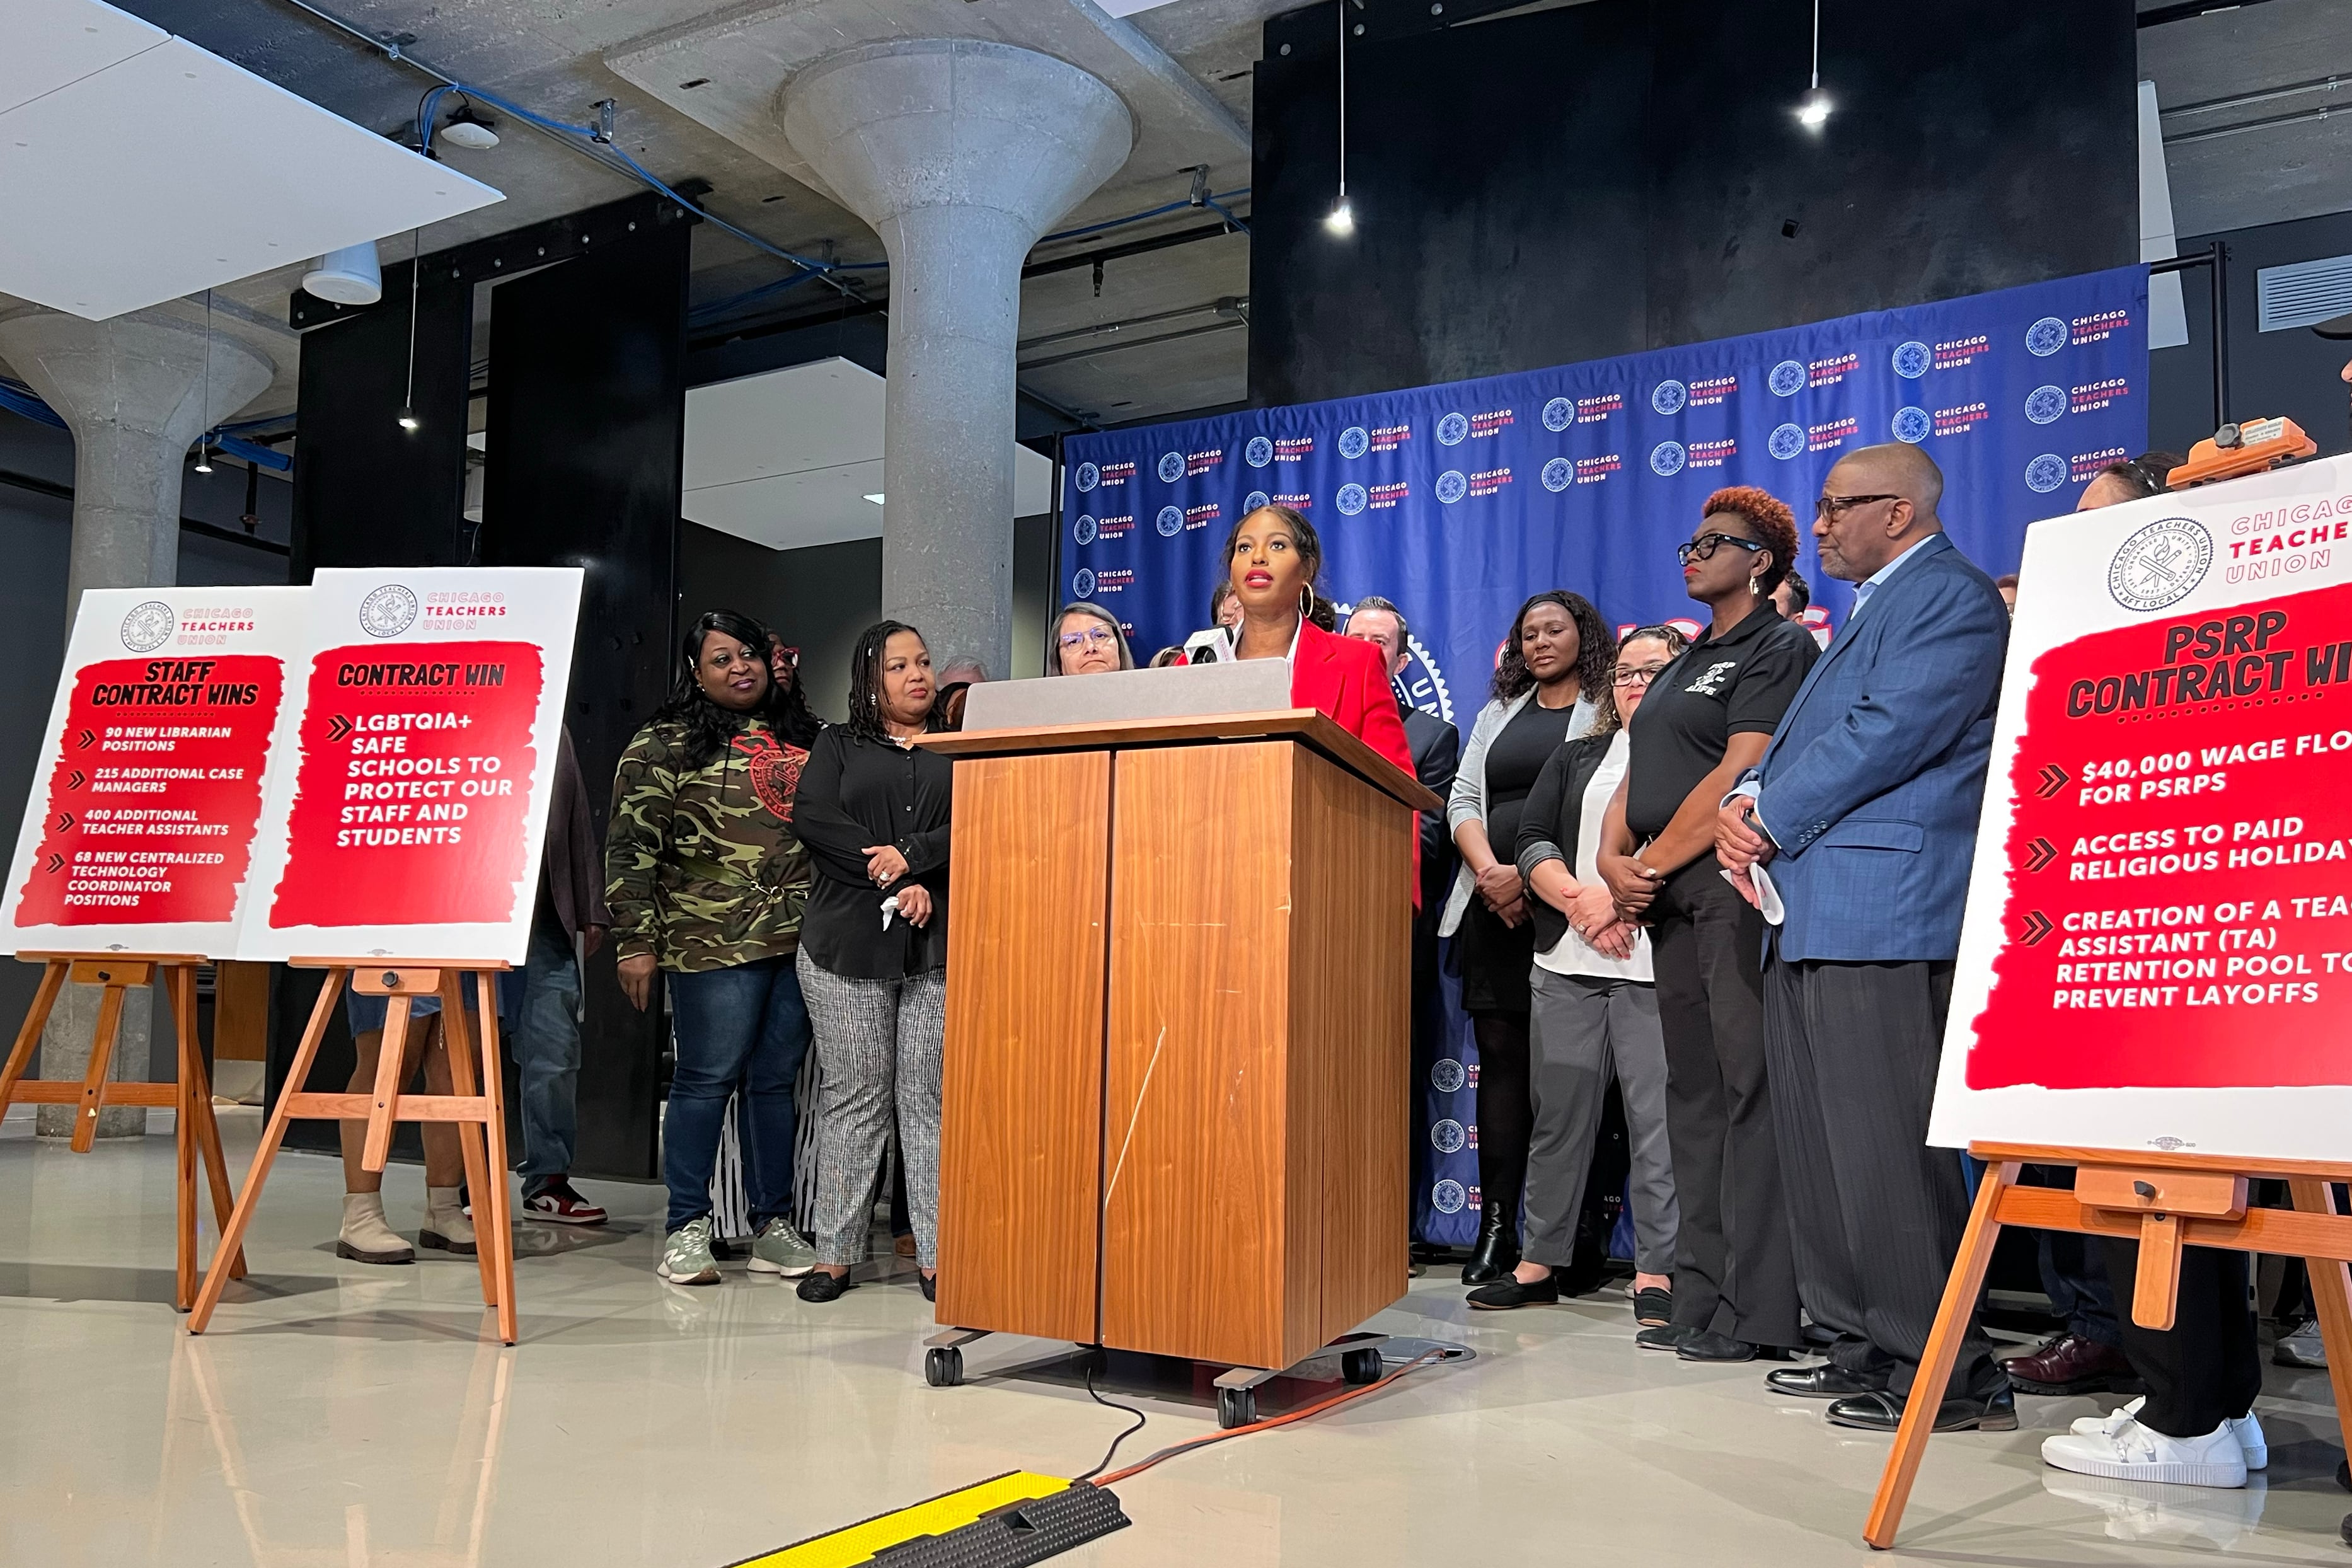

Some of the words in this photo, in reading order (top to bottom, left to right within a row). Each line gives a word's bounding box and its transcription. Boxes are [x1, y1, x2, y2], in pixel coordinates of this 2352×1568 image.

[2072, 309, 2126, 326] CHICAGO
[2073, 318, 2130, 335] TEACHERS
[1935, 335, 1986, 351] CHICAGO
[2072, 331, 2109, 345] UNION
[1935, 343, 1990, 360] TEACHERS
[1809, 353, 1857, 370] CHICAGO
[1935, 357, 1971, 370] UNION
[1809, 360, 1860, 378] TEACHERS
[1690, 376, 1736, 389] CHICAGO
[1809, 374, 1842, 388] UNION
[2071, 378, 2125, 395] CHICAGO
[1690, 384, 1738, 398] TEACHERS
[2072, 386, 2129, 403] TEACHERS
[1577, 394, 1620, 406] CHICAGO
[1690, 396, 1722, 406] UNION
[2072, 399, 2109, 413] UNION
[1578, 401, 1623, 415] TEACHERS
[1935, 402, 1986, 418] CHICAGO
[1472, 409, 1512, 422] CHICAGO
[1472, 415, 1514, 430] TEACHERS
[1577, 412, 1607, 424] UNION
[1935, 410, 1989, 427] TEACHERS
[1371, 425, 1409, 436] CHICAGO
[1809, 417, 1855, 433] CHICAGO
[1935, 424, 1970, 437] UNION
[1371, 431, 1411, 444] TEACHERS
[1471, 427, 1499, 438] UNION
[1809, 425, 1859, 443] TEACHERS
[1275, 437, 1312, 446] CHICAGO
[1371, 442, 1397, 452] UNION
[1688, 439, 1734, 451] CHICAGO
[1809, 438, 1842, 452] UNION
[1187, 449, 1221, 461] CHICAGO
[1689, 446, 1737, 460] TEACHERS
[2071, 447, 2126, 464] CHICAGO
[1102, 462, 1134, 471] CHICAGO
[1577, 454, 1619, 467] CHICAGO
[1689, 459, 1722, 468] UNION
[1188, 466, 1209, 476] UNION
[1470, 468, 1511, 480] CHICAGO
[1577, 461, 1622, 475] TEACHERS
[1102, 478, 1124, 487] UNION
[1470, 475, 1513, 488] TEACHERS
[1577, 473, 1606, 484] UNION
[2072, 471, 2099, 483] UNI
[1369, 481, 1407, 493] CHICAGO
[1470, 486, 1498, 497] UNION
[1272, 493, 1310, 502] CHICAGO
[1370, 488, 1410, 501] TEACHERS
[1186, 504, 1218, 516] CHICAGO
[1369, 500, 1396, 509] UNION
[1100, 516, 1133, 525] CHICAGO
[2232, 495, 2352, 535] CHICAG
[1186, 520, 1207, 531] UNION
[2229, 521, 2349, 559] TEACHE
[2112, 539, 2137, 590] CHICAGO
[2141, 521, 2201, 536] TEACHERS
[2194, 536, 2209, 574] UNION
[2226, 549, 2331, 584] UNION
[1098, 570, 1133, 578] CHICAGO
[427, 592, 505, 602] CHICAGO
[2122, 596, 2140, 607] AFT
[2143, 592, 2181, 608] LOCAL
[183, 608, 253, 618] CHICAGO
[425, 606, 507, 616] TEACHERS
[181, 621, 254, 631] TEACHERS
[424, 620, 477, 630] UNION
[177, 634, 228, 645] UNION
[2164, 610, 2287, 665] PSRP
[144, 661, 217, 683] STAFF
[337, 664, 460, 686] CONTRACT
[466, 664, 505, 686] WIN
[2067, 650, 2295, 718] CONTRACT
[2307, 642, 2352, 687] WI
[91, 684, 204, 706] CONTRACT
[207, 684, 259, 706] WINS
[355, 712, 472, 732] LGBTQIA+
[105, 727, 122, 738] 90
[125, 727, 156, 738] NEW
[159, 727, 231, 738] LIBRARIAN
[101, 740, 176, 751] POSITIONS
[351, 736, 407, 754] SAFE
[2081, 751, 2192, 783] $40,000
[2200, 738, 2286, 768] WAGE
[2295, 730, 2352, 756] FLO
[95, 768, 119, 779] 215
[121, 768, 205, 779] ADDITIONAL
[209, 768, 245, 780] CASE
[347, 758, 461, 778] SCHOOLS
[468, 756, 502, 774] TO
[91, 781, 167, 793] MANAGERS
[344, 780, 456, 801] PROTECT
[460, 779, 514, 797] OUR
[2078, 783, 2131, 807] FOR
[2140, 771, 2227, 800] PSRPS
[85, 809, 111, 821] 400
[113, 810, 199, 821] ADDITIONAL
[340, 804, 412, 824] STAFF
[415, 803, 468, 822] AND
[83, 823, 143, 835] TEACHER
[146, 824, 229, 836] ASSISTANTS
[336, 826, 462, 847] STUDENTS
[2071, 828, 2176, 857] ACCESS
[2183, 824, 2224, 846] TO
[2232, 816, 2304, 842] PAID
[74, 851, 91, 863] 68
[95, 851, 127, 863] NEW
[129, 852, 224, 865] CENTRALIZED
[2069, 851, 2219, 882] RELIGIOUS
[2228, 839, 2352, 869] HOLIDA
[72, 865, 168, 879] TECHNOLOGY
[67, 880, 172, 892] COORDINATOR
[64, 894, 140, 906] POSITIONS
[2062, 904, 2205, 932] CREATION
[2213, 901, 2255, 923] OF
[2261, 899, 2282, 921] A
[2291, 895, 2352, 918] TEA
[2058, 931, 2211, 958] ASSISTANT
[2218, 926, 2277, 952] (TA)
[2056, 957, 2217, 983] RETENTION
[2226, 953, 2312, 977] POOL
[2052, 986, 2179, 1010] PREVENT
[2186, 981, 2319, 1007] LAYOFFS
